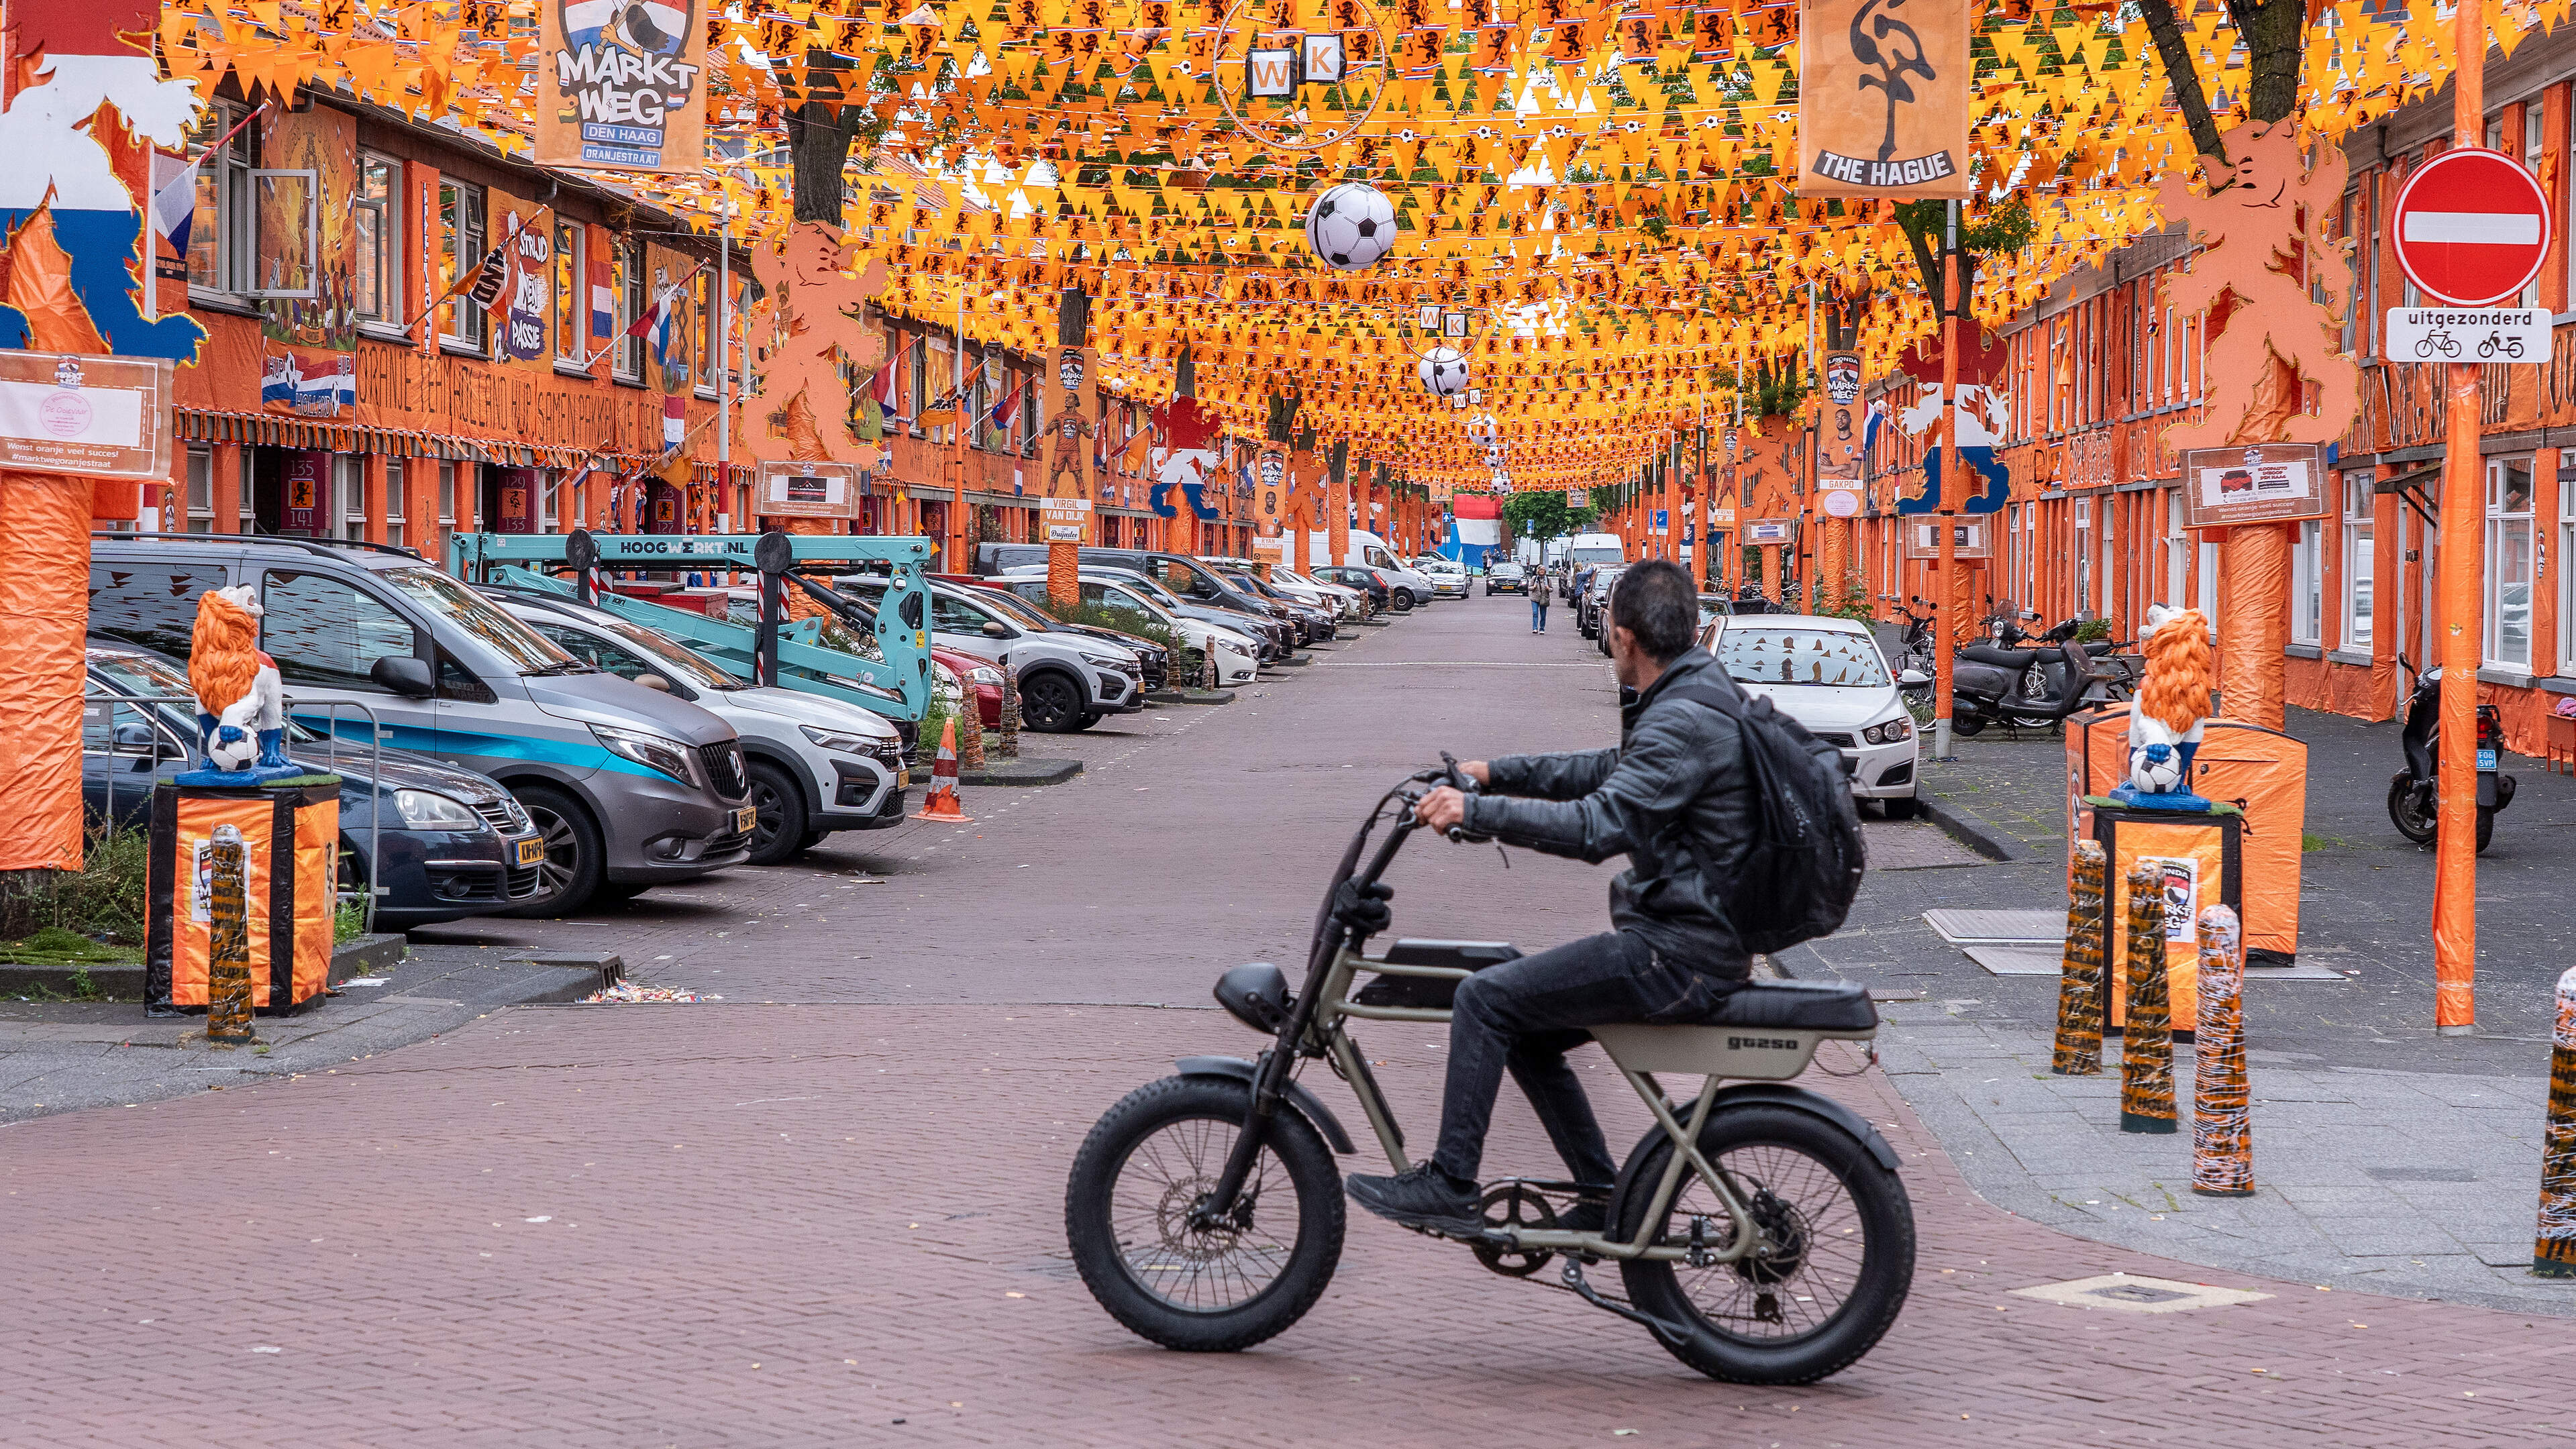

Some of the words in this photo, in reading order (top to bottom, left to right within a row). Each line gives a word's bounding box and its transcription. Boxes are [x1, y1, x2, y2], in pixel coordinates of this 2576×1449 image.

[556, 43, 699, 89] MARKT
[1253, 61, 1290, 88] W
[1312, 46, 1333, 73] K
[579, 80, 664, 125] WEG
[589, 127, 615, 139] DEN
[620, 129, 656, 142] HAAG
[586, 149, 656, 164] ORANJESTRAAT
[1822, 152, 1864, 183] THE
[1870, 153, 1950, 185] HAGUE
[519, 229, 548, 263] STRIJD
[1422, 311, 1439, 325] W
[1451, 319, 1460, 333] K
[2409, 311, 2532, 329] uitgezonderd
[512, 319, 540, 350] PASSIE
[267, 354, 284, 378] HUP
[337, 354, 351, 377] HUP
[358, 345, 412, 412] ORANJE
[418, 354, 452, 416] TEAM
[1827, 381, 1861, 391] MARKT
[1454, 397, 1464, 406] W
[1472, 392, 1478, 401] K
[1833, 390, 1853, 400] WEG
[295, 392, 332, 418] HOLLAND
[7, 442, 33, 451] Wenst
[36, 445, 64, 454] oranje
[67, 446, 85, 455] veel
[12, 453, 111, 468] #marktwegoranjestraat
[290, 460, 314, 476] 135
[505, 475, 525, 488] 129
[1260, 470, 1284, 478] MARKT
[1828, 480, 1855, 488] GAKPO
[1053, 499, 1079, 509] VIRGIL
[290, 511, 314, 526] 141
[1046, 510, 1065, 521] VAN
[1067, 510, 1085, 521] DIJK
[2221, 509, 2293, 519] #marktwegoranjestraat
[505, 517, 525, 531] 133
[656, 522, 674, 534] 127
[2165, 904, 2193, 917] RKT
